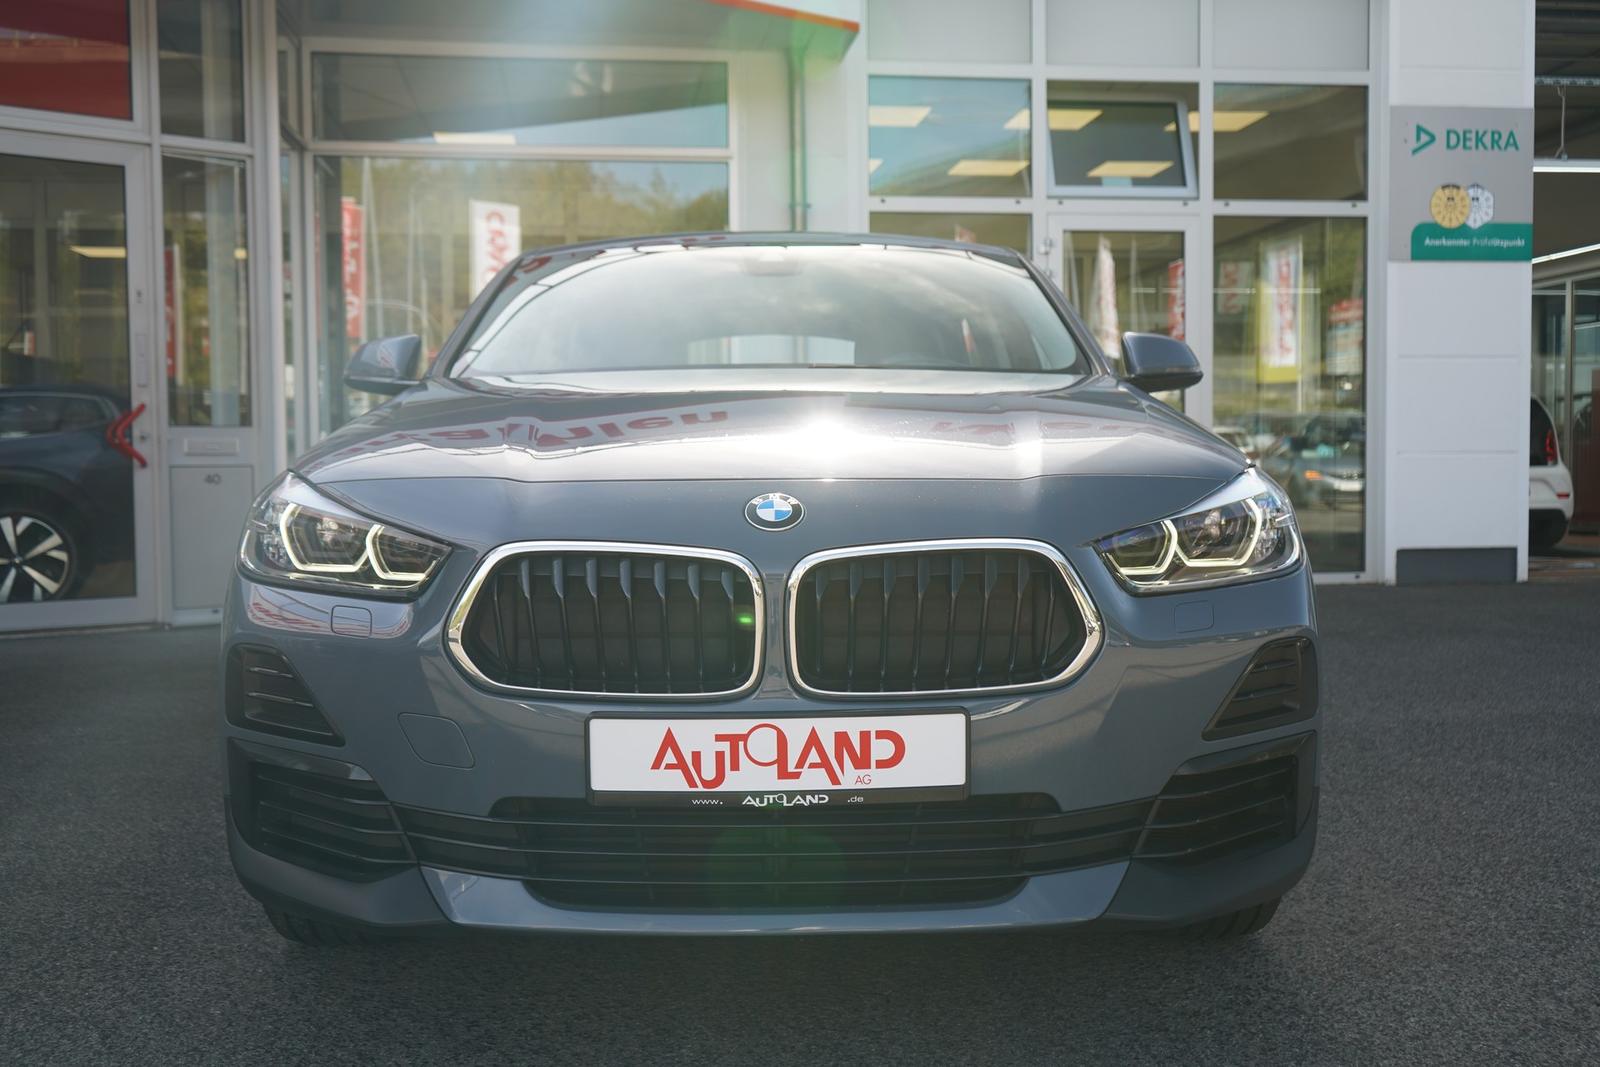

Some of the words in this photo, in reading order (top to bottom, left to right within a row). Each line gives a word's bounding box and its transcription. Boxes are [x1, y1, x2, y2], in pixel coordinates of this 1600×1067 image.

[1445, 128, 1520, 151] DEKRA
[650, 723, 906, 790] AUTOLAND
[854, 774, 873, 786] AG
